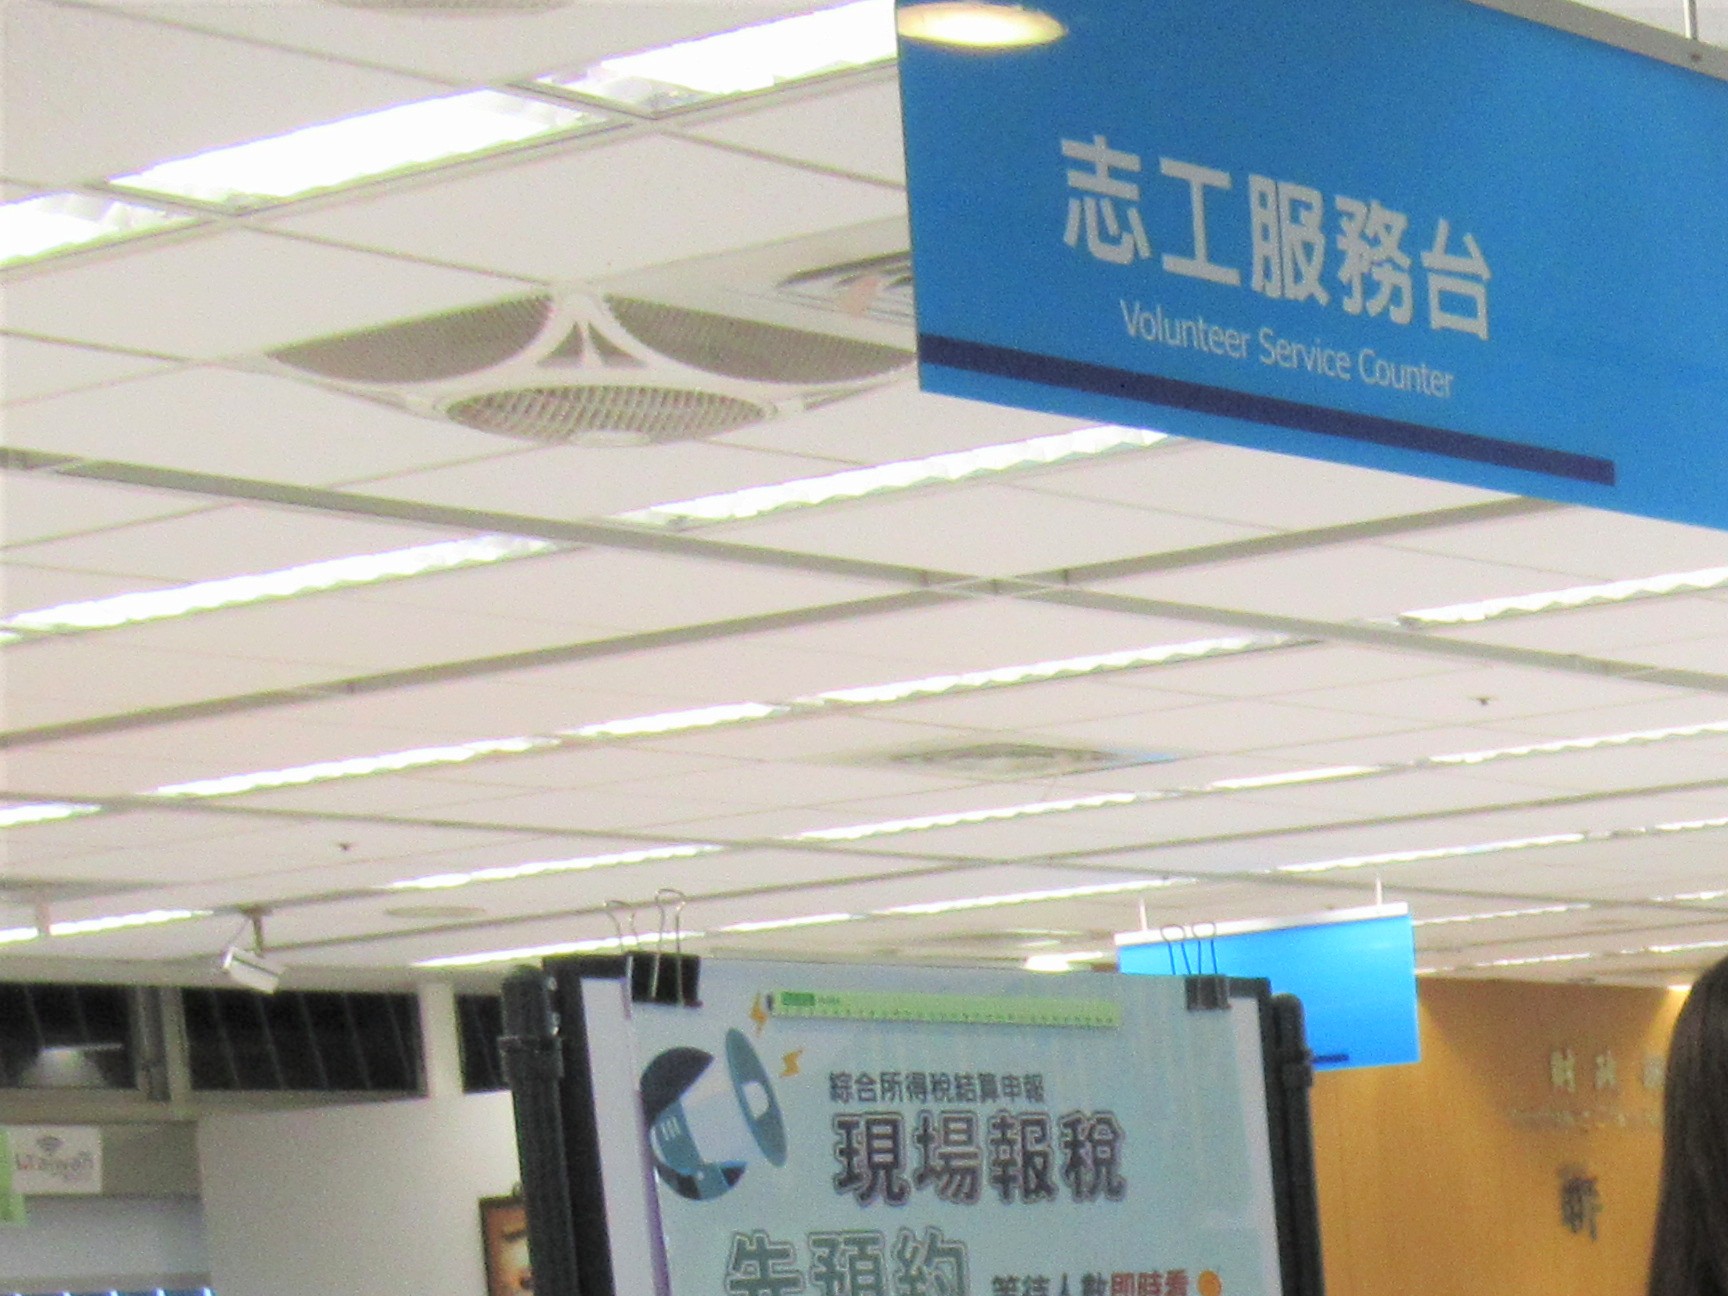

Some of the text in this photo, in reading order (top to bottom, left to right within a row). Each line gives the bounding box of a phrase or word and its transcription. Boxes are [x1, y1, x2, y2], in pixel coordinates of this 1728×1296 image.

[1059, 134, 1492, 342] 志工服務台
[1119, 298, 1456, 400] Volunteer Service Counter
[827, 1071, 1046, 1104] 綜合所得稅結算申報
[832, 1108, 1126, 1206] 現場報稅
